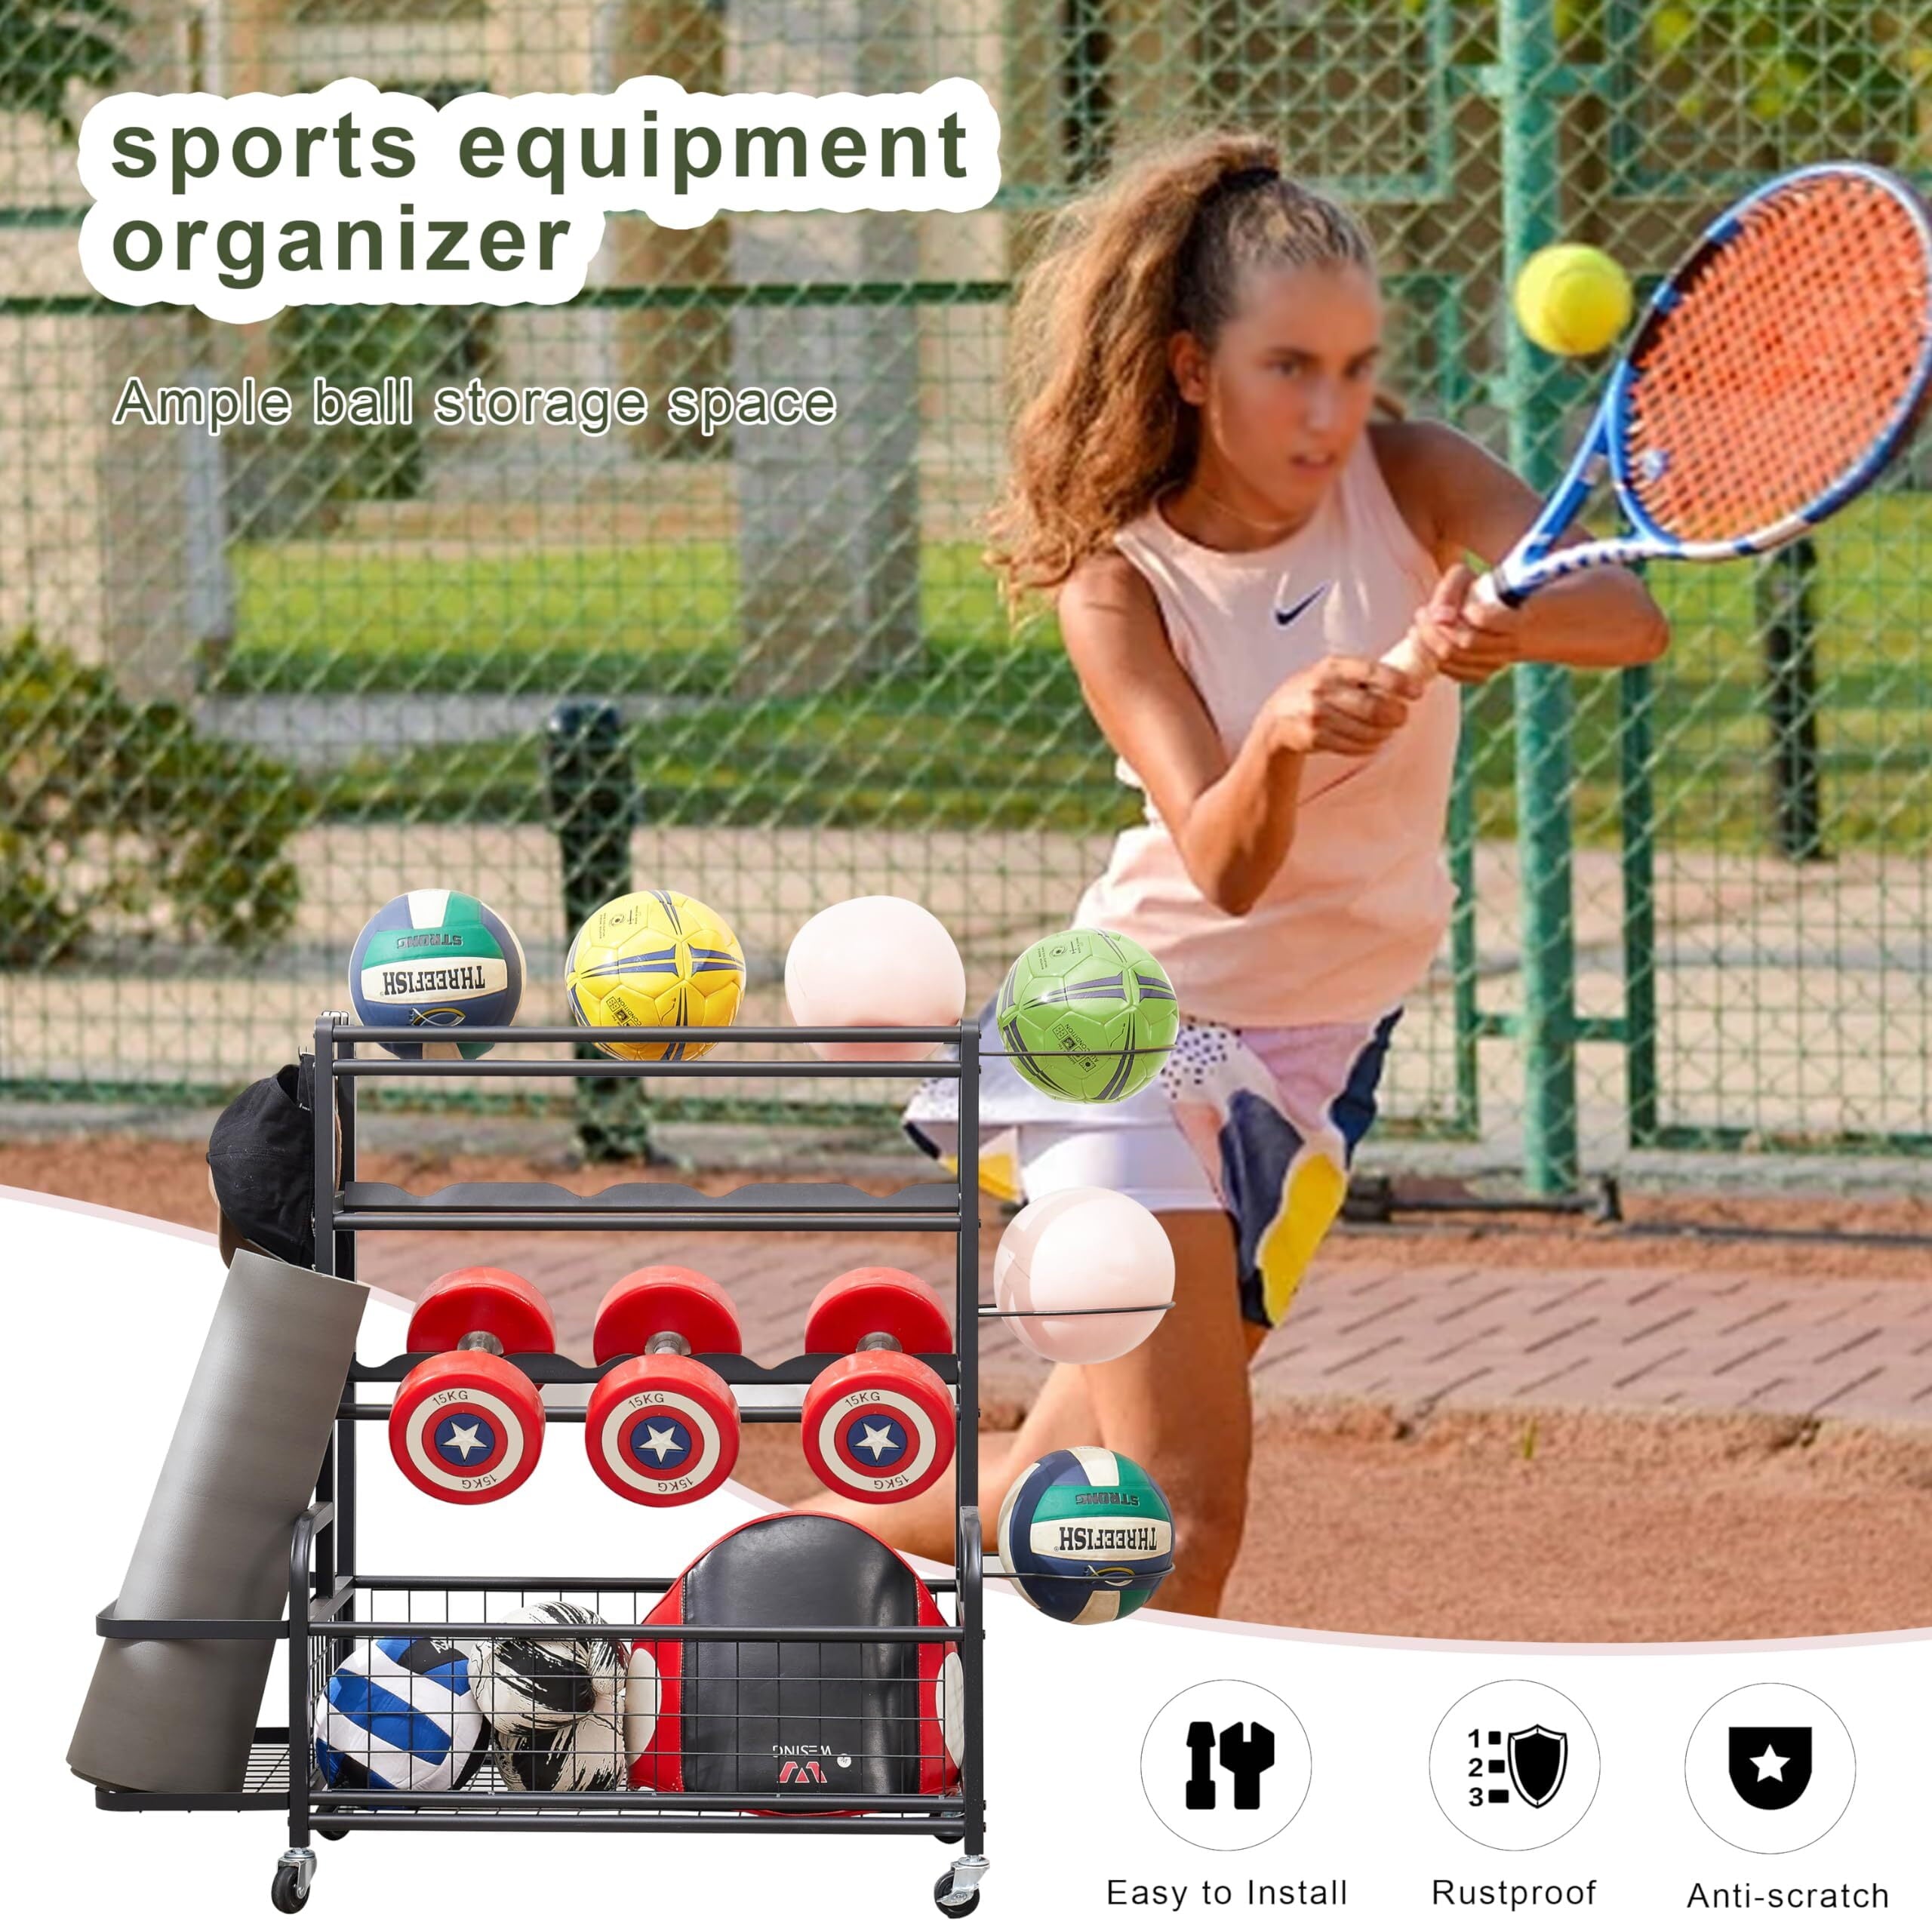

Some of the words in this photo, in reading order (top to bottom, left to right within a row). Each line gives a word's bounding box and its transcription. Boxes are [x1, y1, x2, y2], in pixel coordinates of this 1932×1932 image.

[397, 934, 464, 949] STRONG
[383, 966, 485, 995] THREEFISH
[432, 1390, 469, 1407] 15KG
[629, 1393, 665, 1409] 15KG
[844, 1391, 881, 1407] 15KG
[461, 1474, 498, 1490] 15KG
[657, 1476, 693, 1493] 15KG
[873, 1474, 910, 1490] 15KG
[1075, 1491, 1140, 1506] STRONG
[1060, 1527, 1158, 1552] THREEFISH
